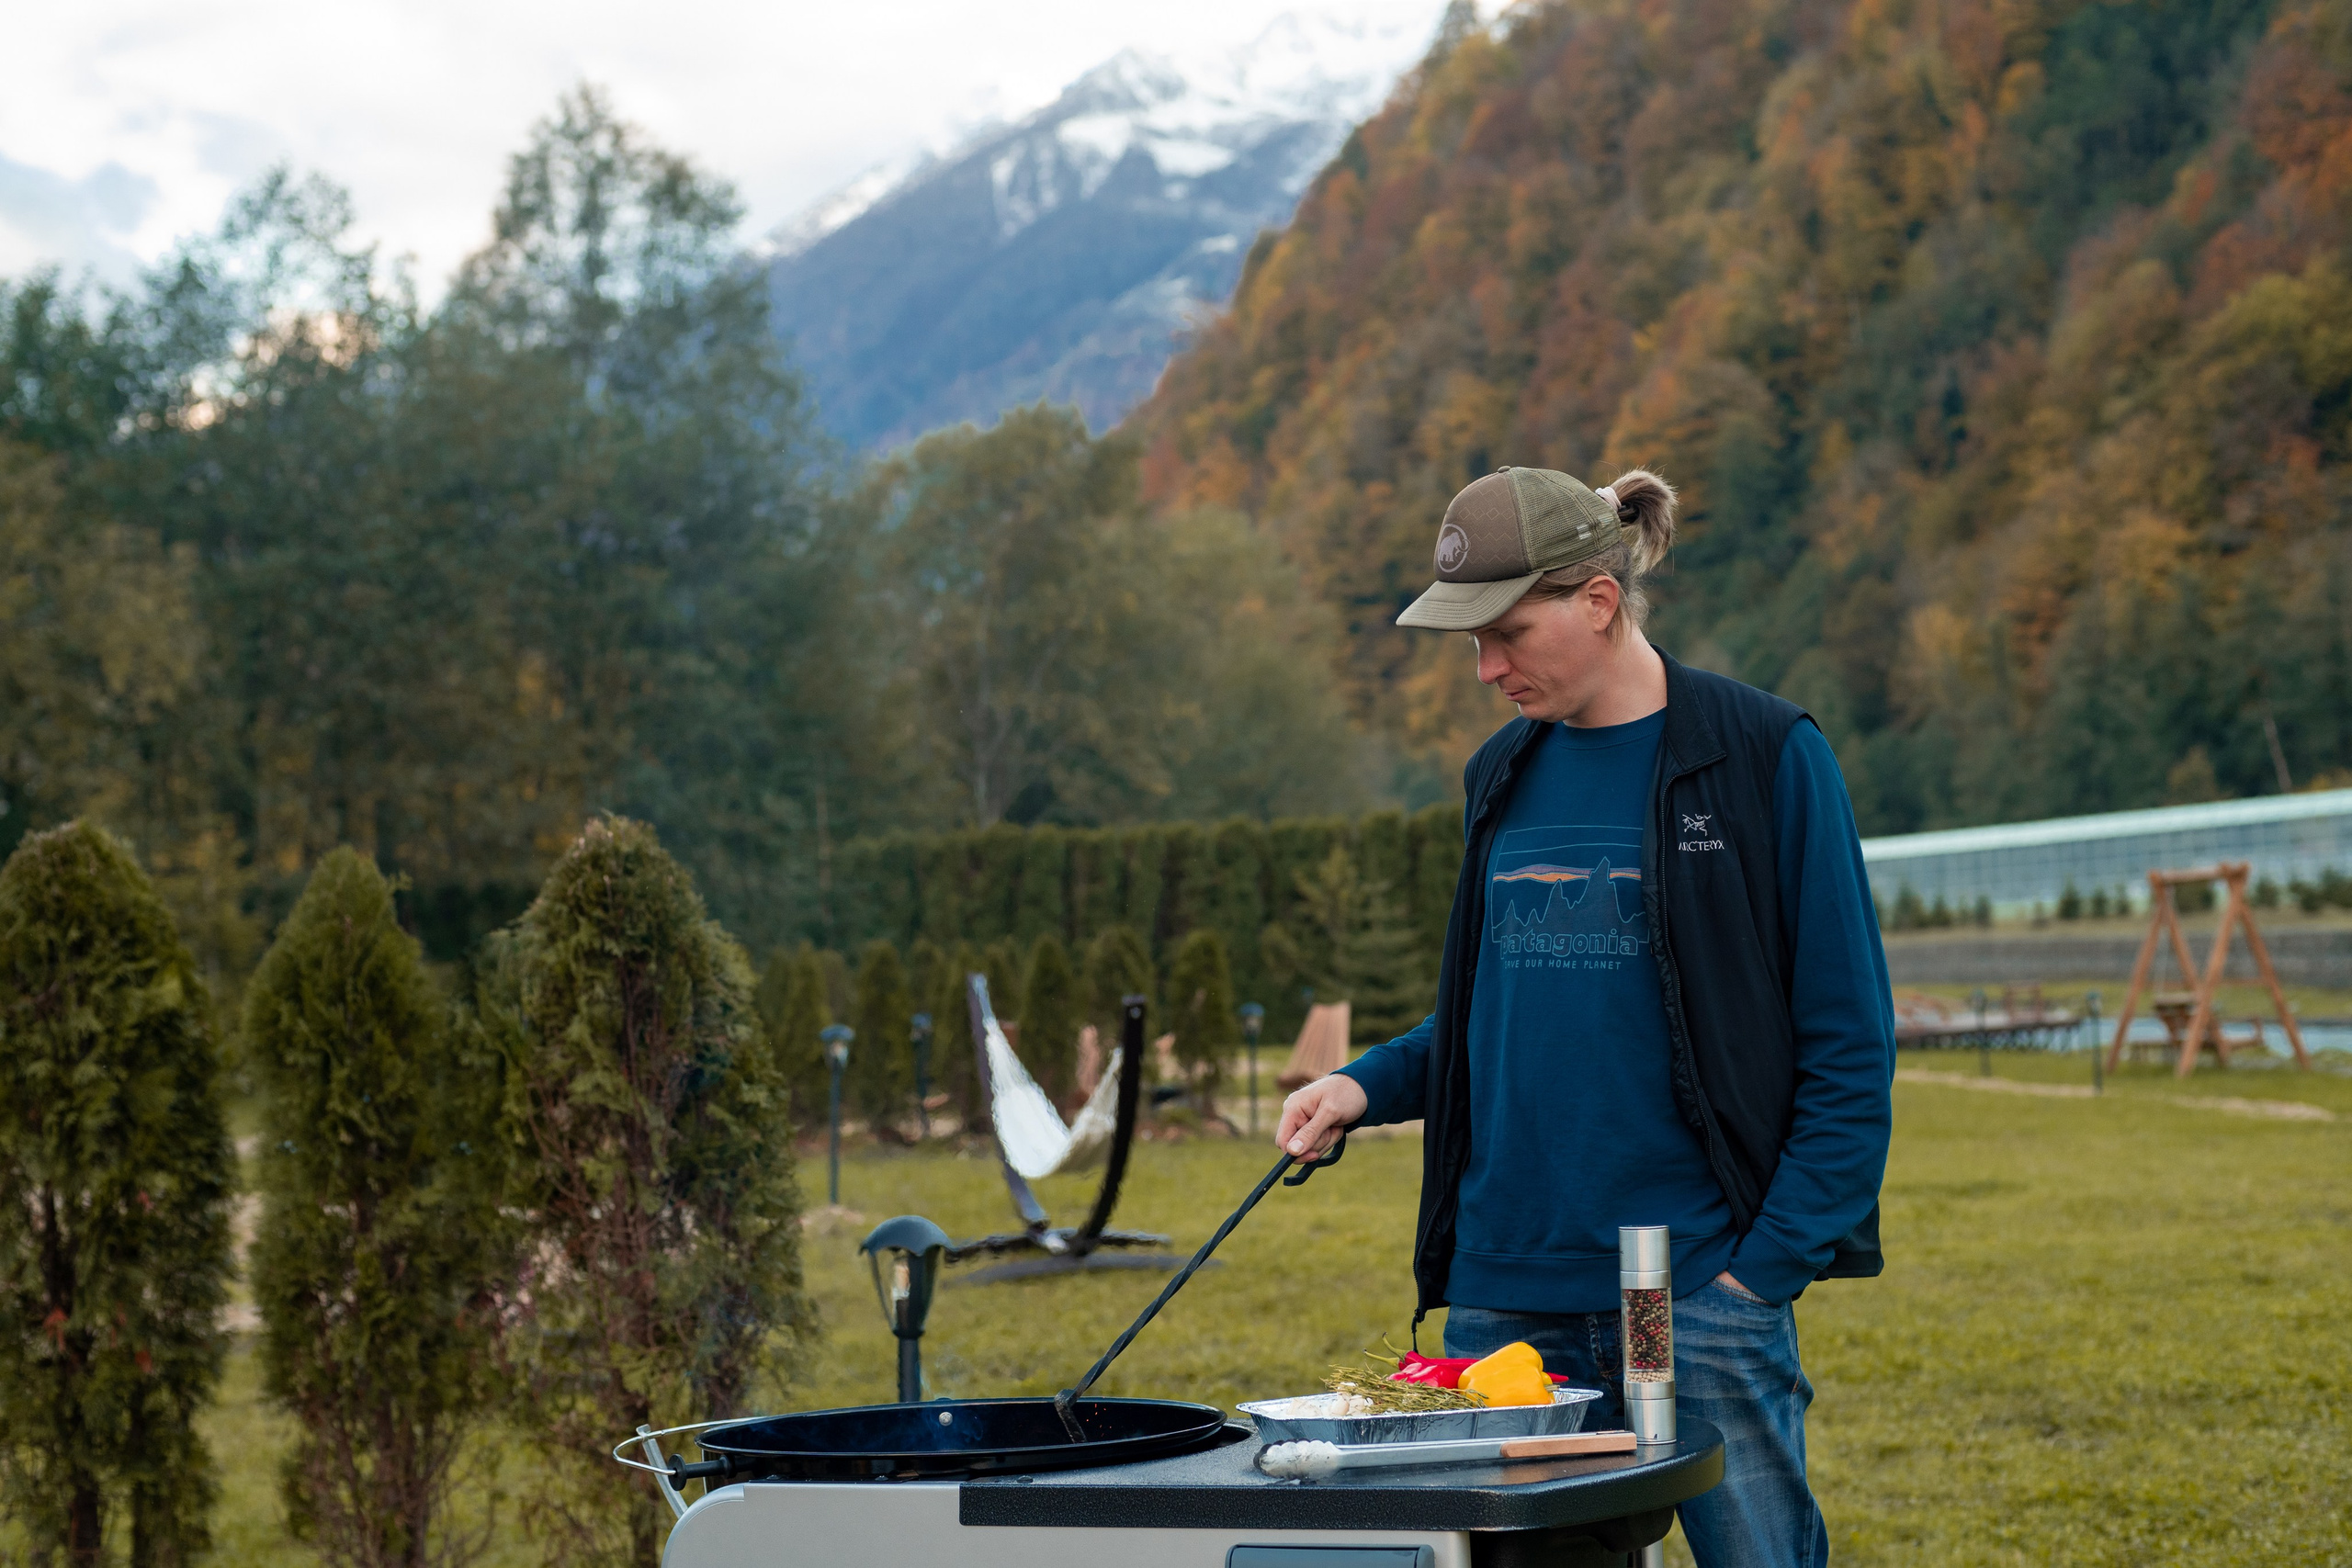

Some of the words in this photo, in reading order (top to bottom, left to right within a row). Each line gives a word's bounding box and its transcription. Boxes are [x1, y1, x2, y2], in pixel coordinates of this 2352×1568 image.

[1500, 928, 1639, 959] patagonia
[1504, 960, 1520, 969] SAVE
[1525, 959, 1543, 968] OUR
[1548, 960, 1577, 969] HOME
[1583, 960, 1622, 970] PLANET
